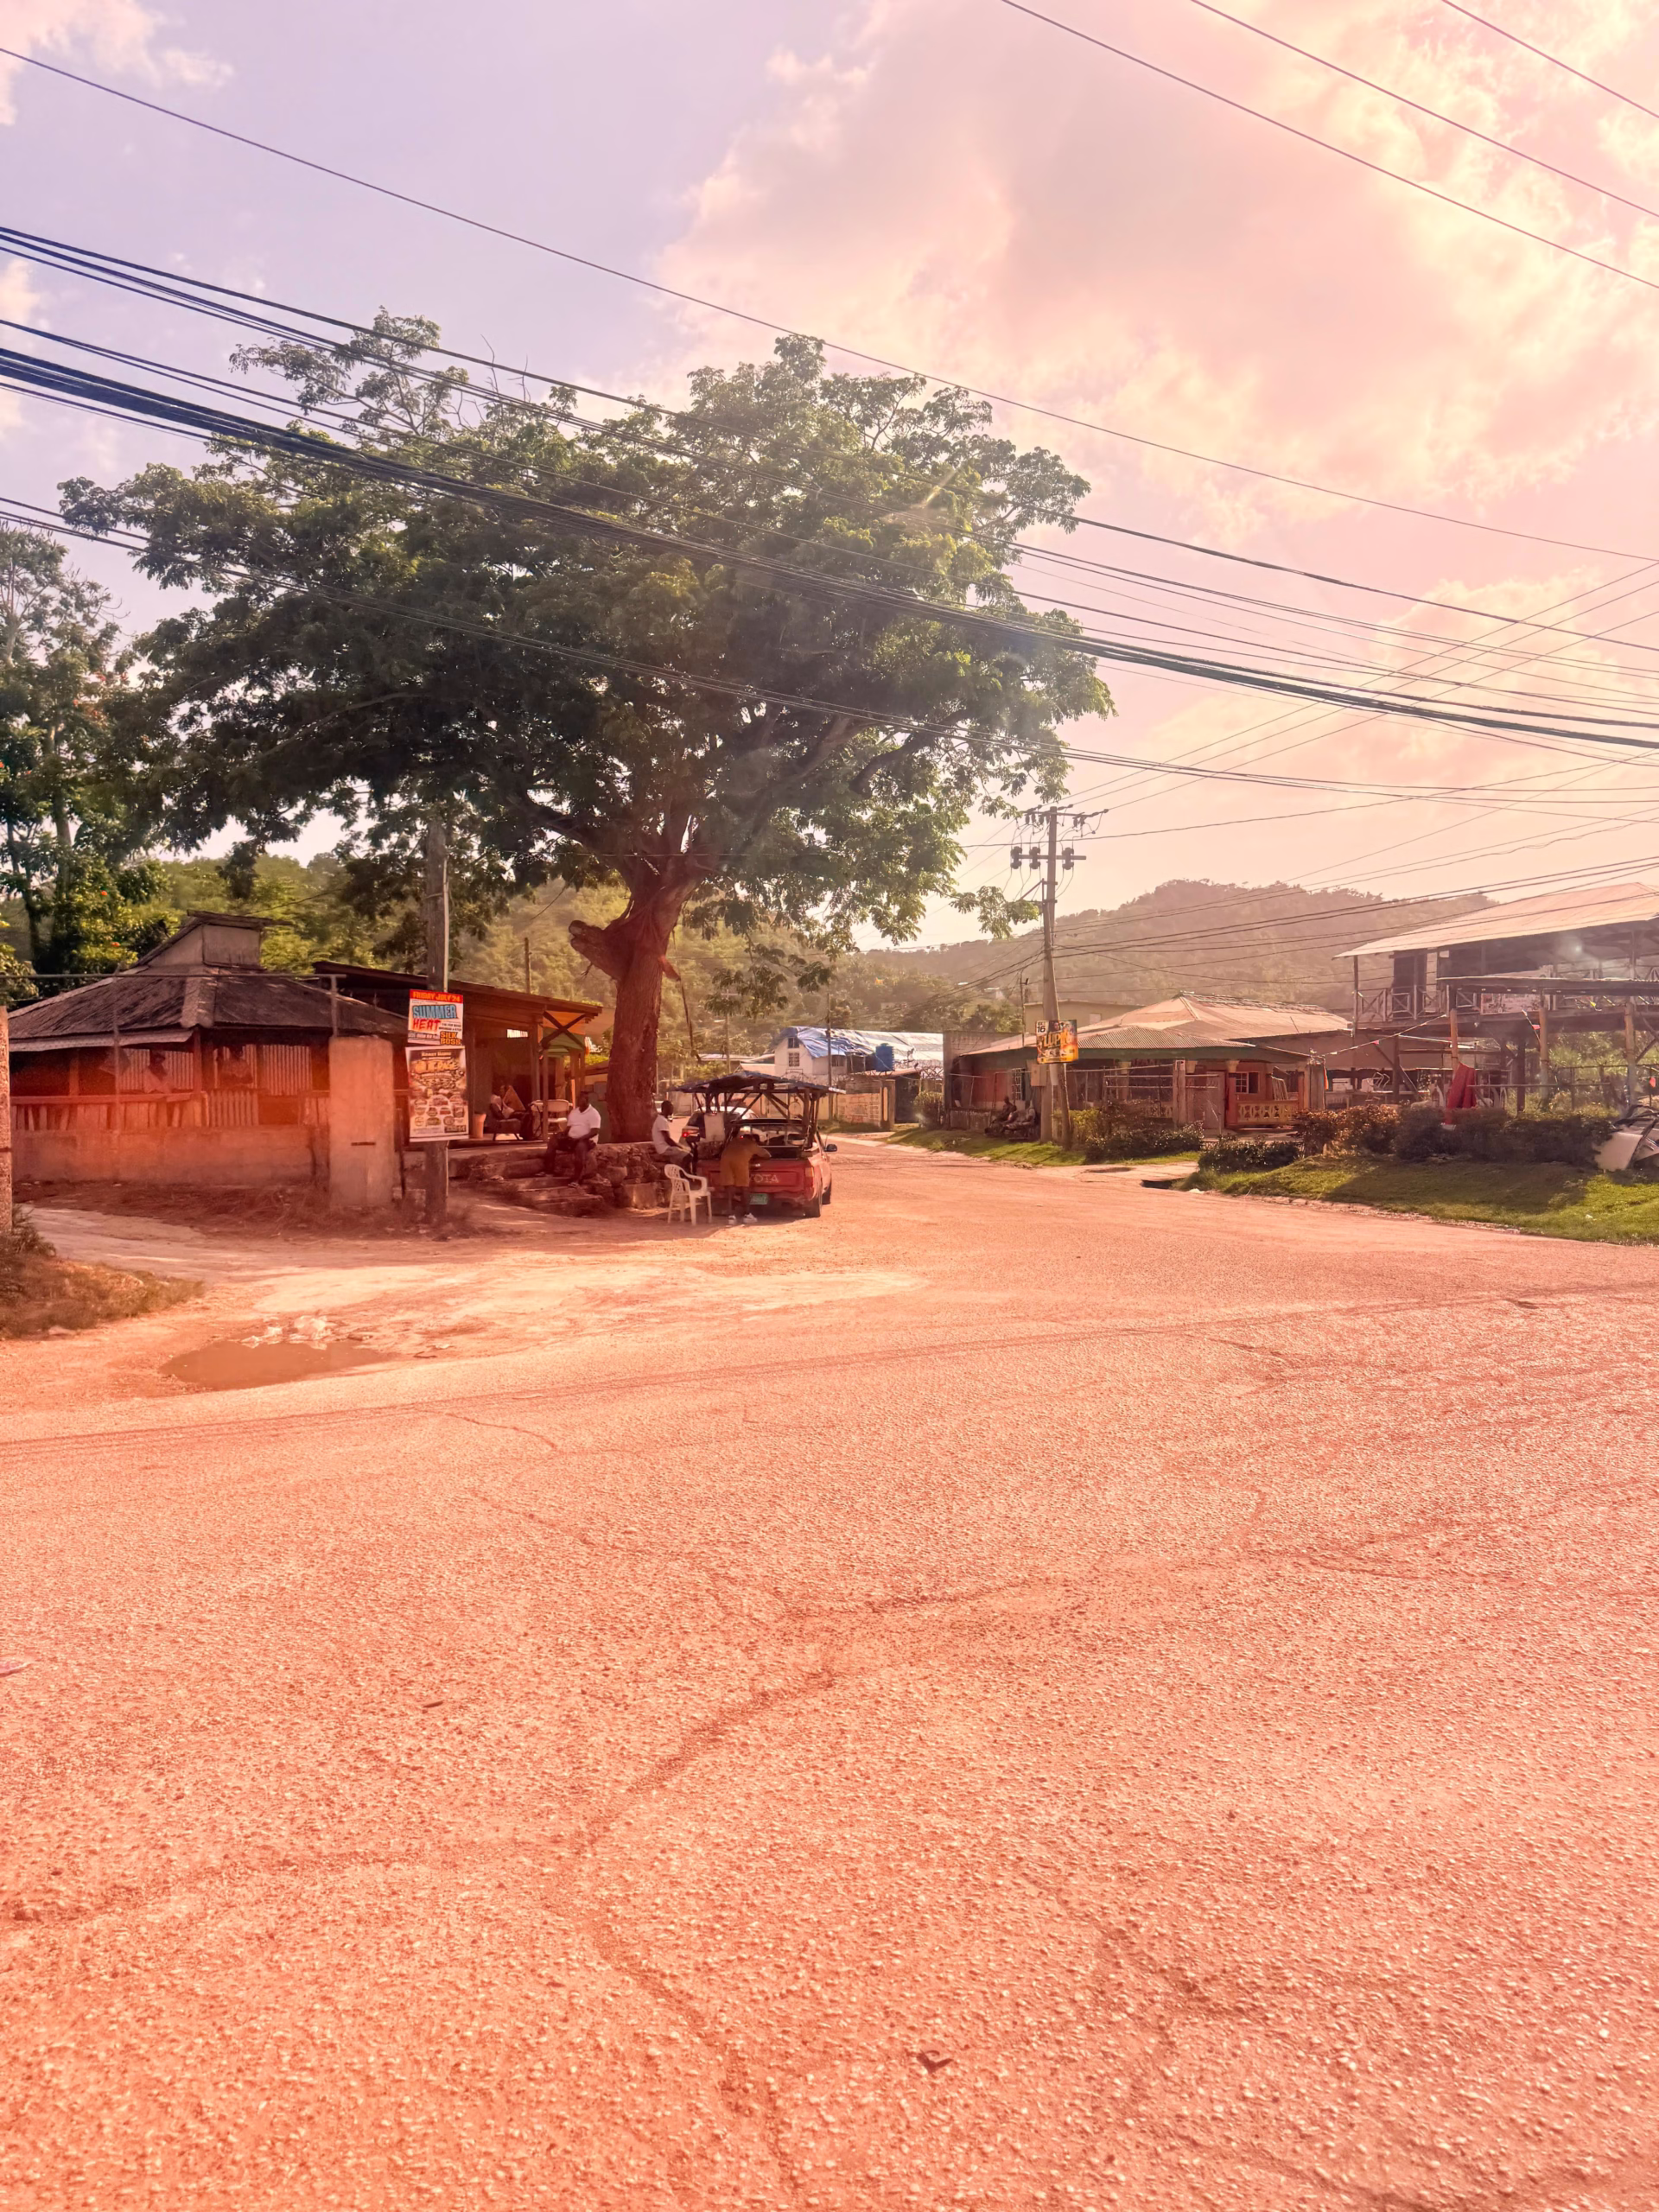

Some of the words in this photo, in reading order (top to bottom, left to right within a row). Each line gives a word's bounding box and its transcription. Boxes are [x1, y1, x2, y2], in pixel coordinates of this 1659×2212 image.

[413, 991, 435, 1001] FRIDAY
[412, 1004, 457, 1019] SUMMER
[412, 1018, 441, 1032] HEAT
